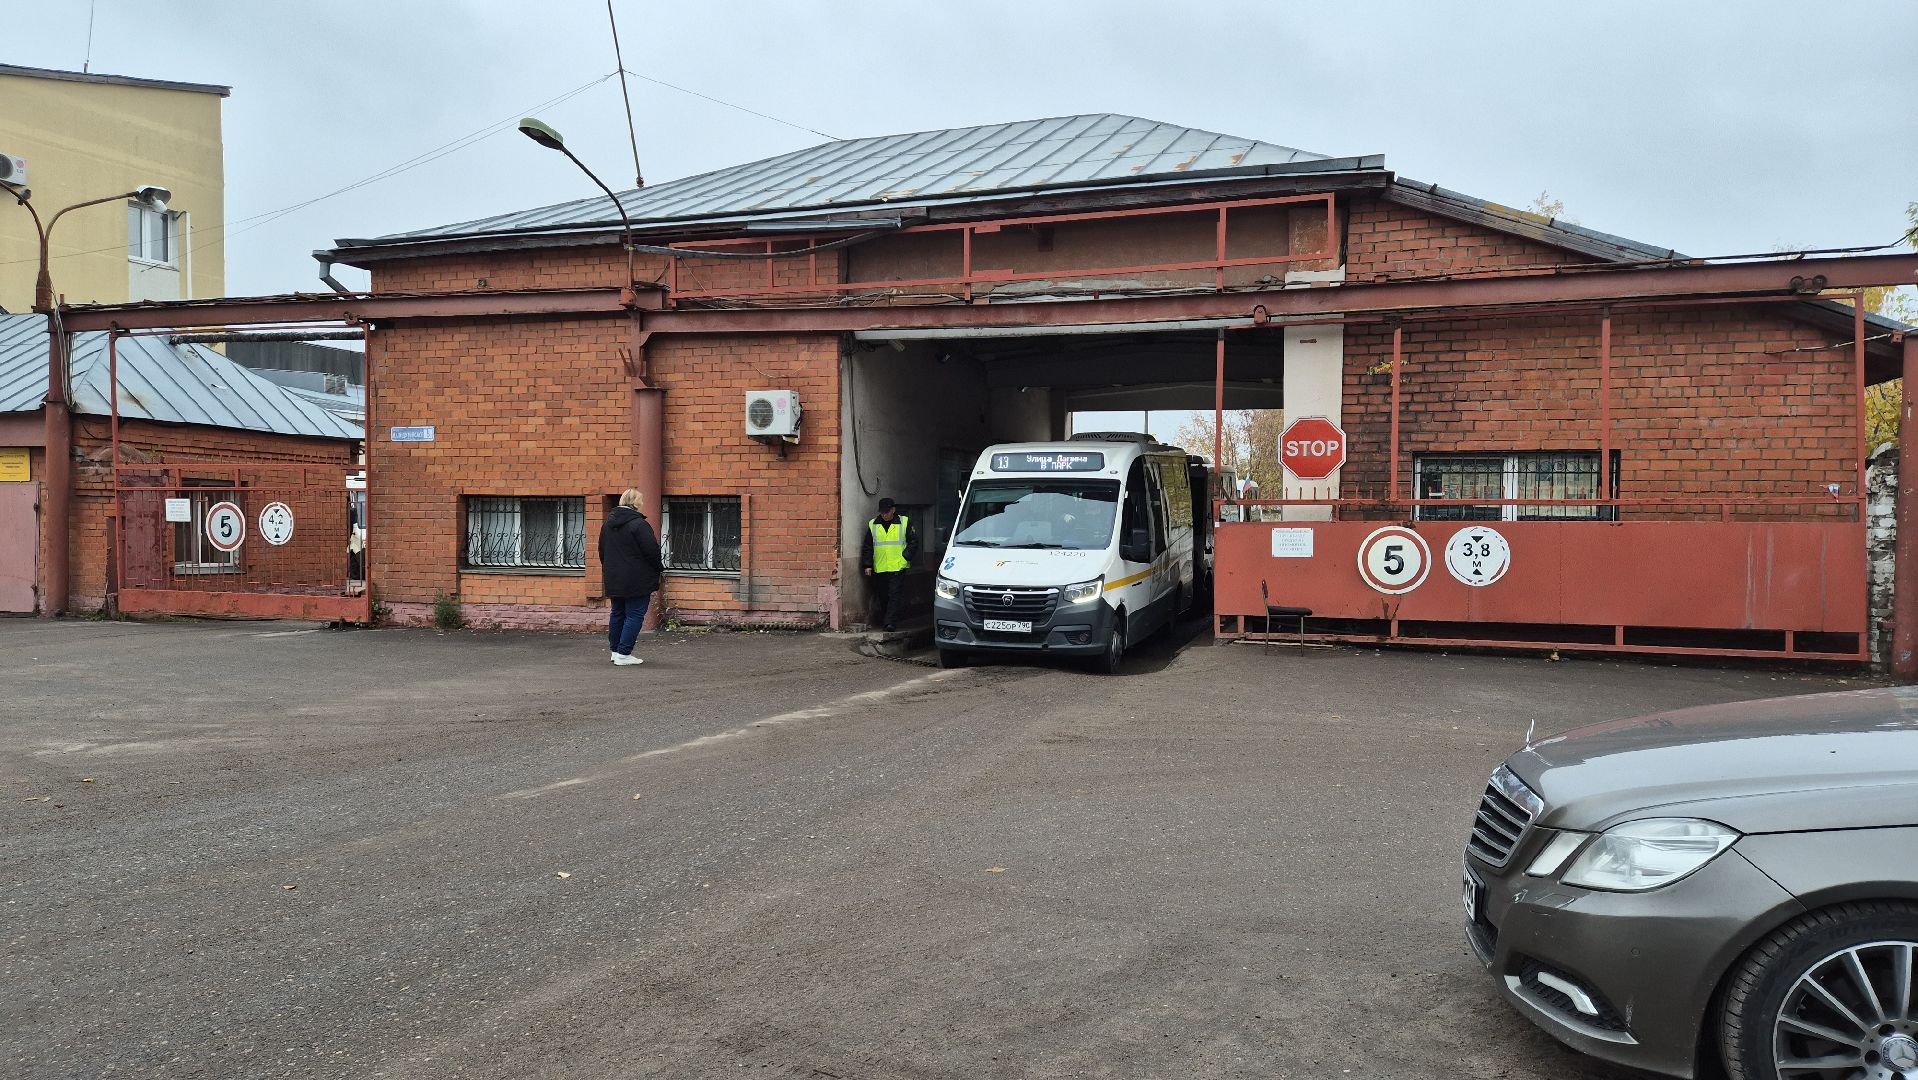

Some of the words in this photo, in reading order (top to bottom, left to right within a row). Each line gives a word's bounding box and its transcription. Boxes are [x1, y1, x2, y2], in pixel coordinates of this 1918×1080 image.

[1286, 440, 1340, 457] STOP
[997, 456, 1009, 469] 13
[1026, 455, 1053, 463] Улица
[1051, 462, 1073, 470] ПАРК
[220, 516, 233, 538] 5
[268, 514, 284, 527] 4,2
[1462, 542, 1491, 560] 3,8
[1383, 545, 1405, 576] 5
